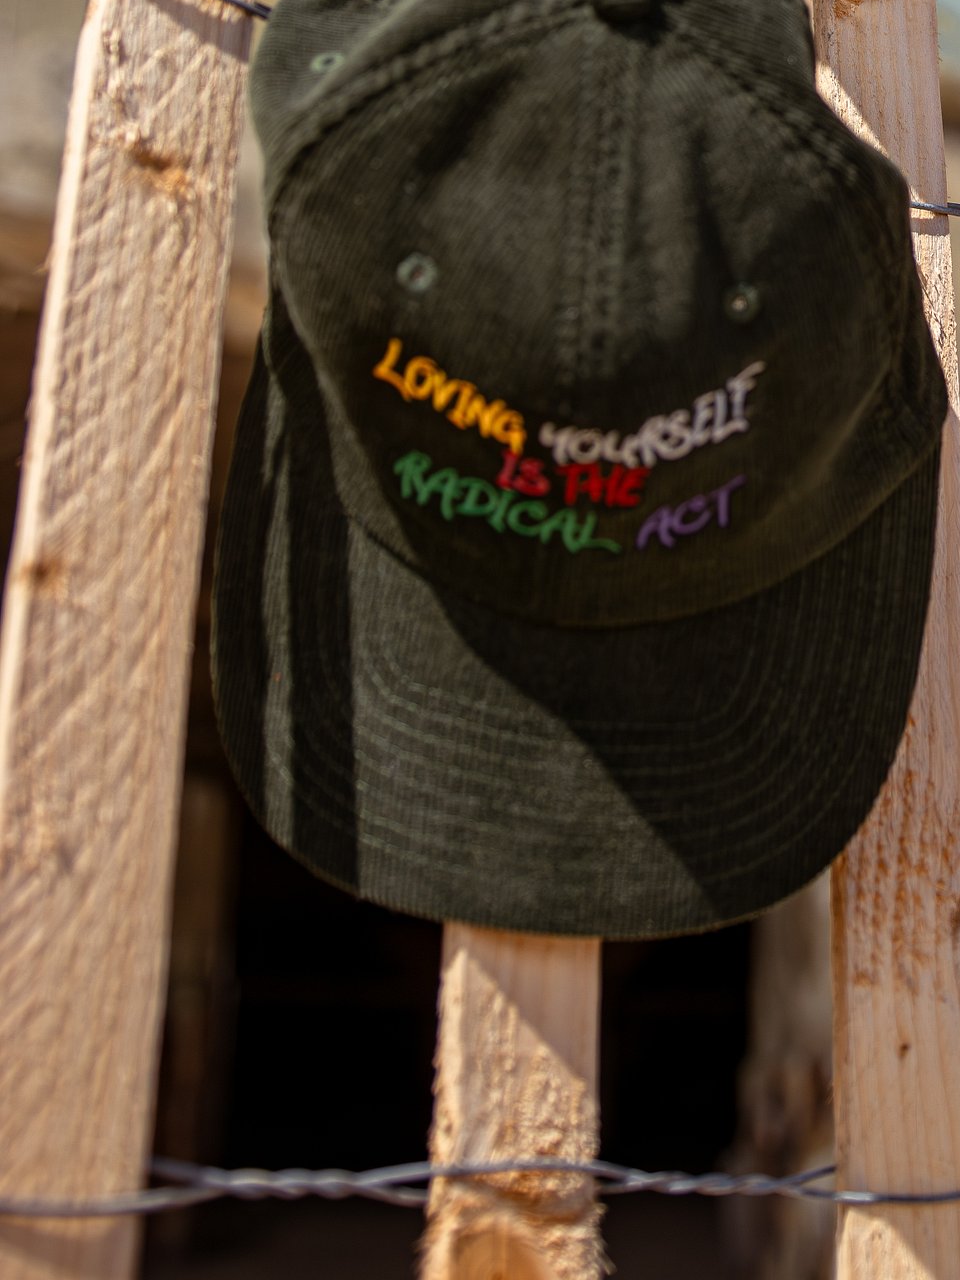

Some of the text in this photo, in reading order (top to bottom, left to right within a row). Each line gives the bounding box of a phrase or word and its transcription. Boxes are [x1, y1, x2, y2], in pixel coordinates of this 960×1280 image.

[372, 338, 766, 468] LOVING YOURSELF
[394, 450, 748, 554] RADICAL ACT
[497, 451, 650, 507] IS THE
